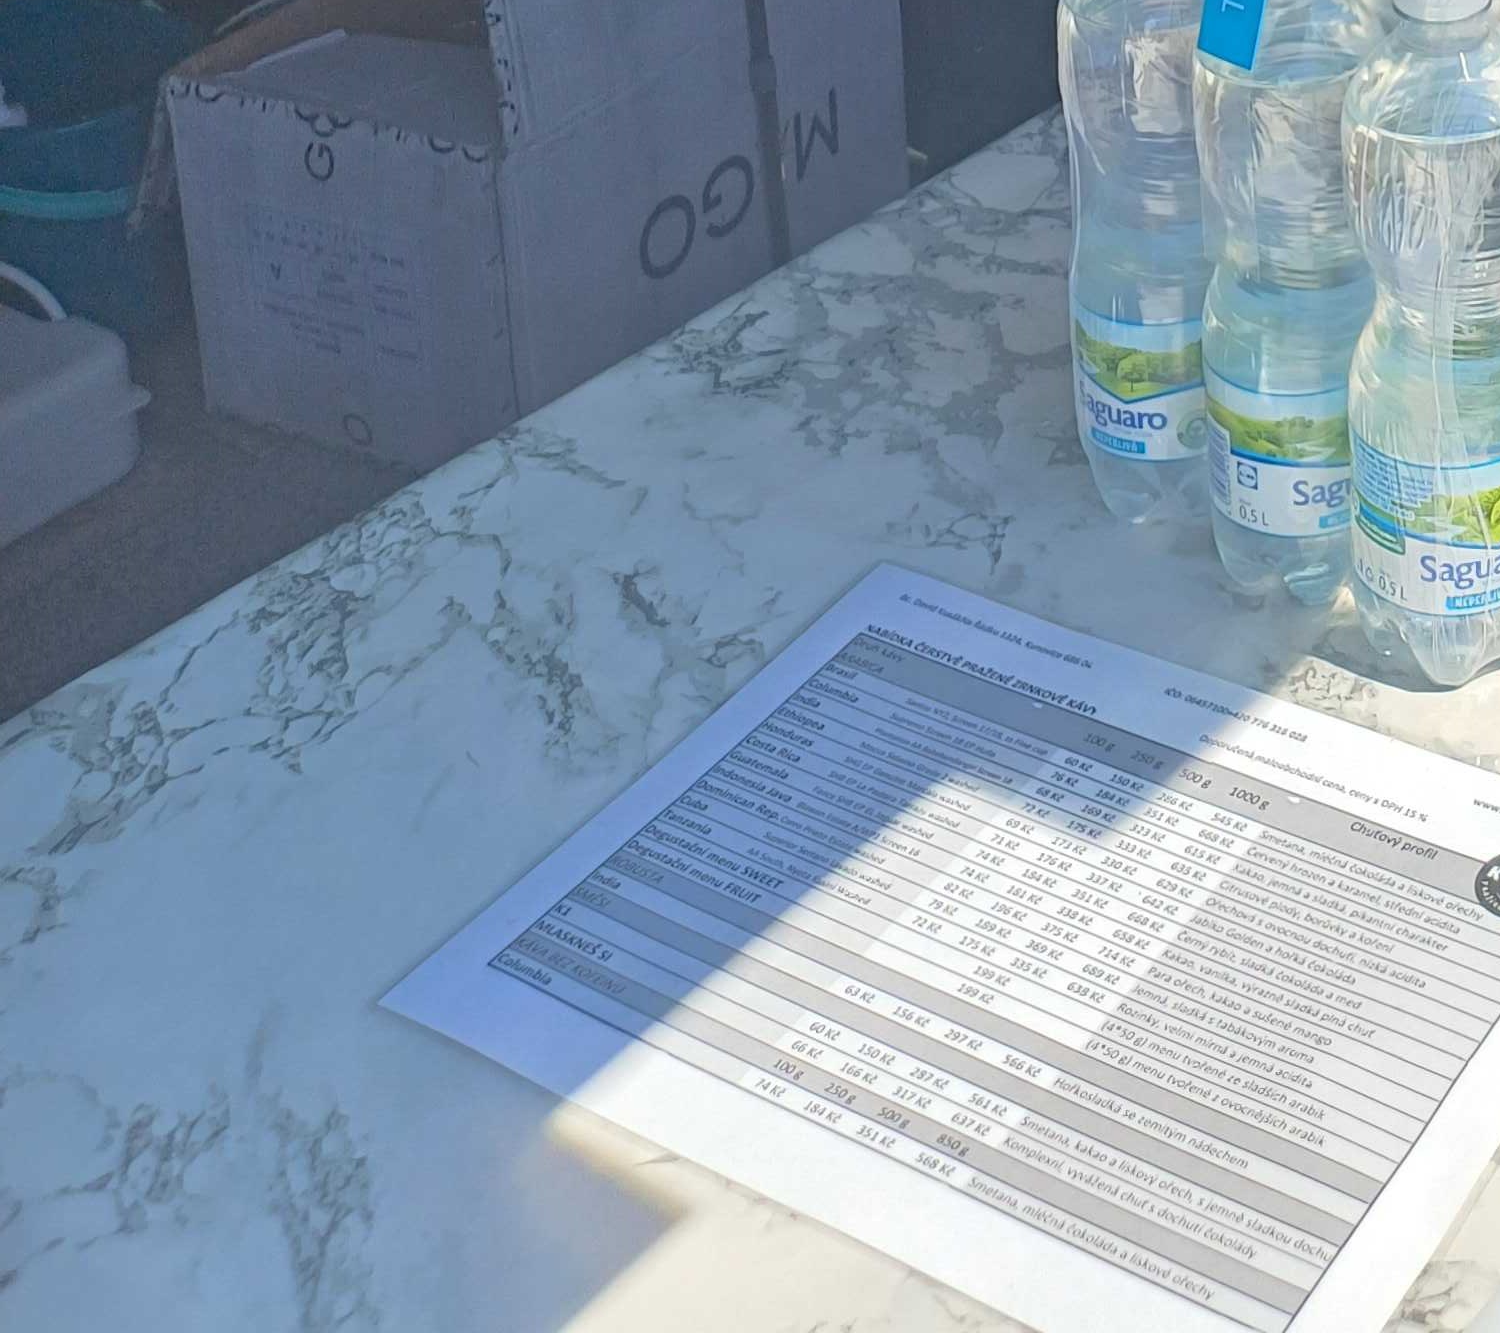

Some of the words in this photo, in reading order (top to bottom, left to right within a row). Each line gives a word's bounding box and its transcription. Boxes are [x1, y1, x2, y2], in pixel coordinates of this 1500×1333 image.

[1239, 504, 1259, 524] 0,5
[824, 662, 859, 680] Brasil
[866, 623, 914, 647] NABÍDKA
[913, 641, 964, 665] ČERSTVĚ
[961, 660, 1016, 684] PRAŽENÉ
[1011, 679, 1069, 704] ZRNKOVÉ
[1065, 698, 1098, 715] KÁVY
[792, 692, 822, 708] India
[807, 678, 860, 703] Columbia
[776, 706, 826, 731] Ethiopea
[745, 734, 778, 753] Costa
[776, 747, 802, 763] Rica
[760, 721, 815, 747] Honduras
[729, 750, 790, 780] Guatemala
[1082, 732, 1108, 747] 100
[1178, 767, 1204, 783] 500
[1199, 779, 1213, 789] g
[1228, 786, 1262, 805] 1000
[1257, 799, 1271, 811] g
[712, 764, 767, 792] Indonesia
[765, 787, 794, 803] Java
[679, 794, 709, 811] Cuba
[695, 779, 756, 808] Dominican
[754, 803, 780, 820] Rep.
[663, 808, 713, 835] Tanzania
[1349, 820, 1403, 847] Chuťový
[1399, 841, 1439, 860] profil
[643, 823, 710, 856] Degustační
[705, 852, 742, 871] menu
[739, 865, 785, 889] SWEET
[591, 870, 622, 889] India
[626, 839, 692, 871] Degustační
[688, 867, 725, 888] menu
[722, 881, 763, 903] FRUIT
[553, 903, 573, 916] K1
[535, 919, 603, 955] MLASKNEŠ
[597, 949, 614, 962] SI
[496, 953, 553, 985] Columbia
[972, 964, 996, 980] 199
[994, 974, 1012, 987] Kč
[956, 982, 981, 997] 199
[977, 992, 996, 1004] Kč
[1146, 965, 1173, 983] Para
[1292, 1026, 1333, 1046] mango
[1147, 1042, 1182, 1060] menu
[1181, 1054, 1227, 1079] tvořené
[1241, 1079, 1288, 1103] sladších
[1287, 1099, 1326, 1120] arabik
[1131, 1060, 1167, 1079] menu
[1165, 1073, 1213, 1098] tvořené
[1288, 1126, 1325, 1147] arabik
[1136, 1115, 1187, 1142] zemitým
[1187, 1137, 1249, 1169] nádechem
[1245, 1218, 1293, 1244] sladkou
